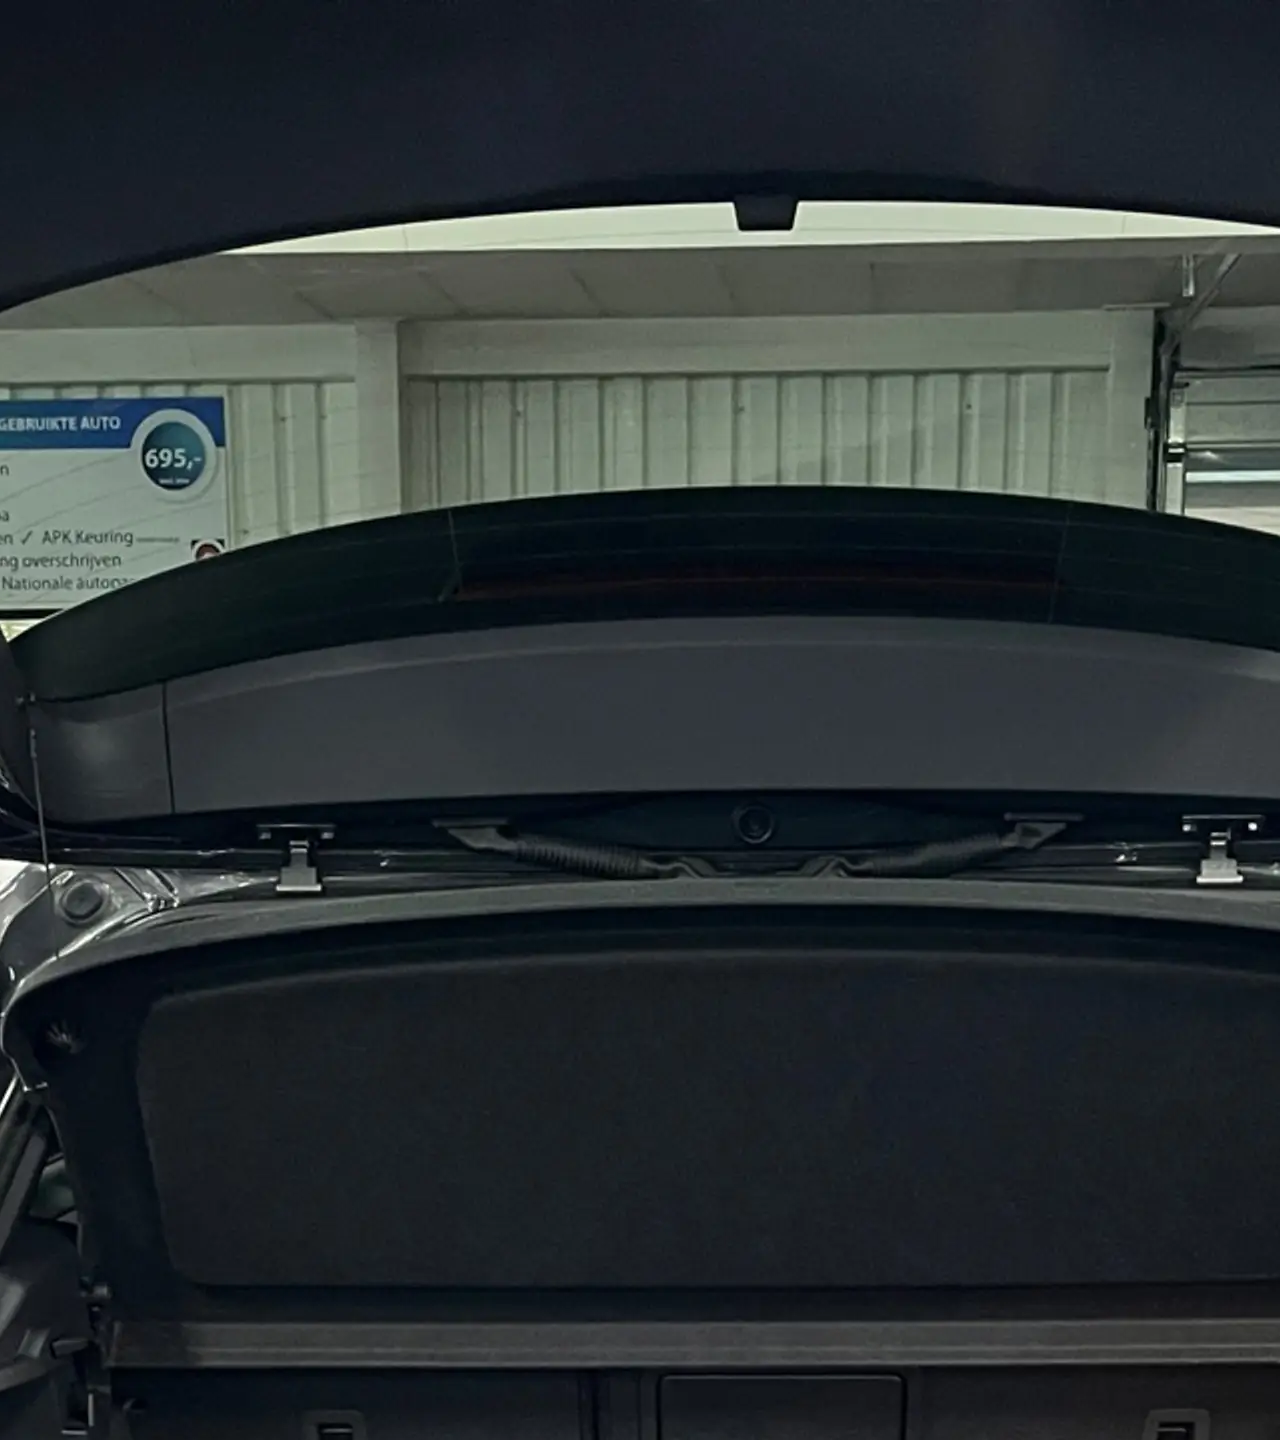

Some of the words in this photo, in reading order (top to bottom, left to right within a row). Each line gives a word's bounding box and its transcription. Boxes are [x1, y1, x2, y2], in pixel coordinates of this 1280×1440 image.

[80, 416, 121, 430] AUTO
[145, 447, 202, 471] 695,-
[41, 531, 72, 545] APK
[75, 530, 134, 548] Keuring
[21, 553, 122, 572] overschrijven
[1, 575, 74, 591] Nationale
